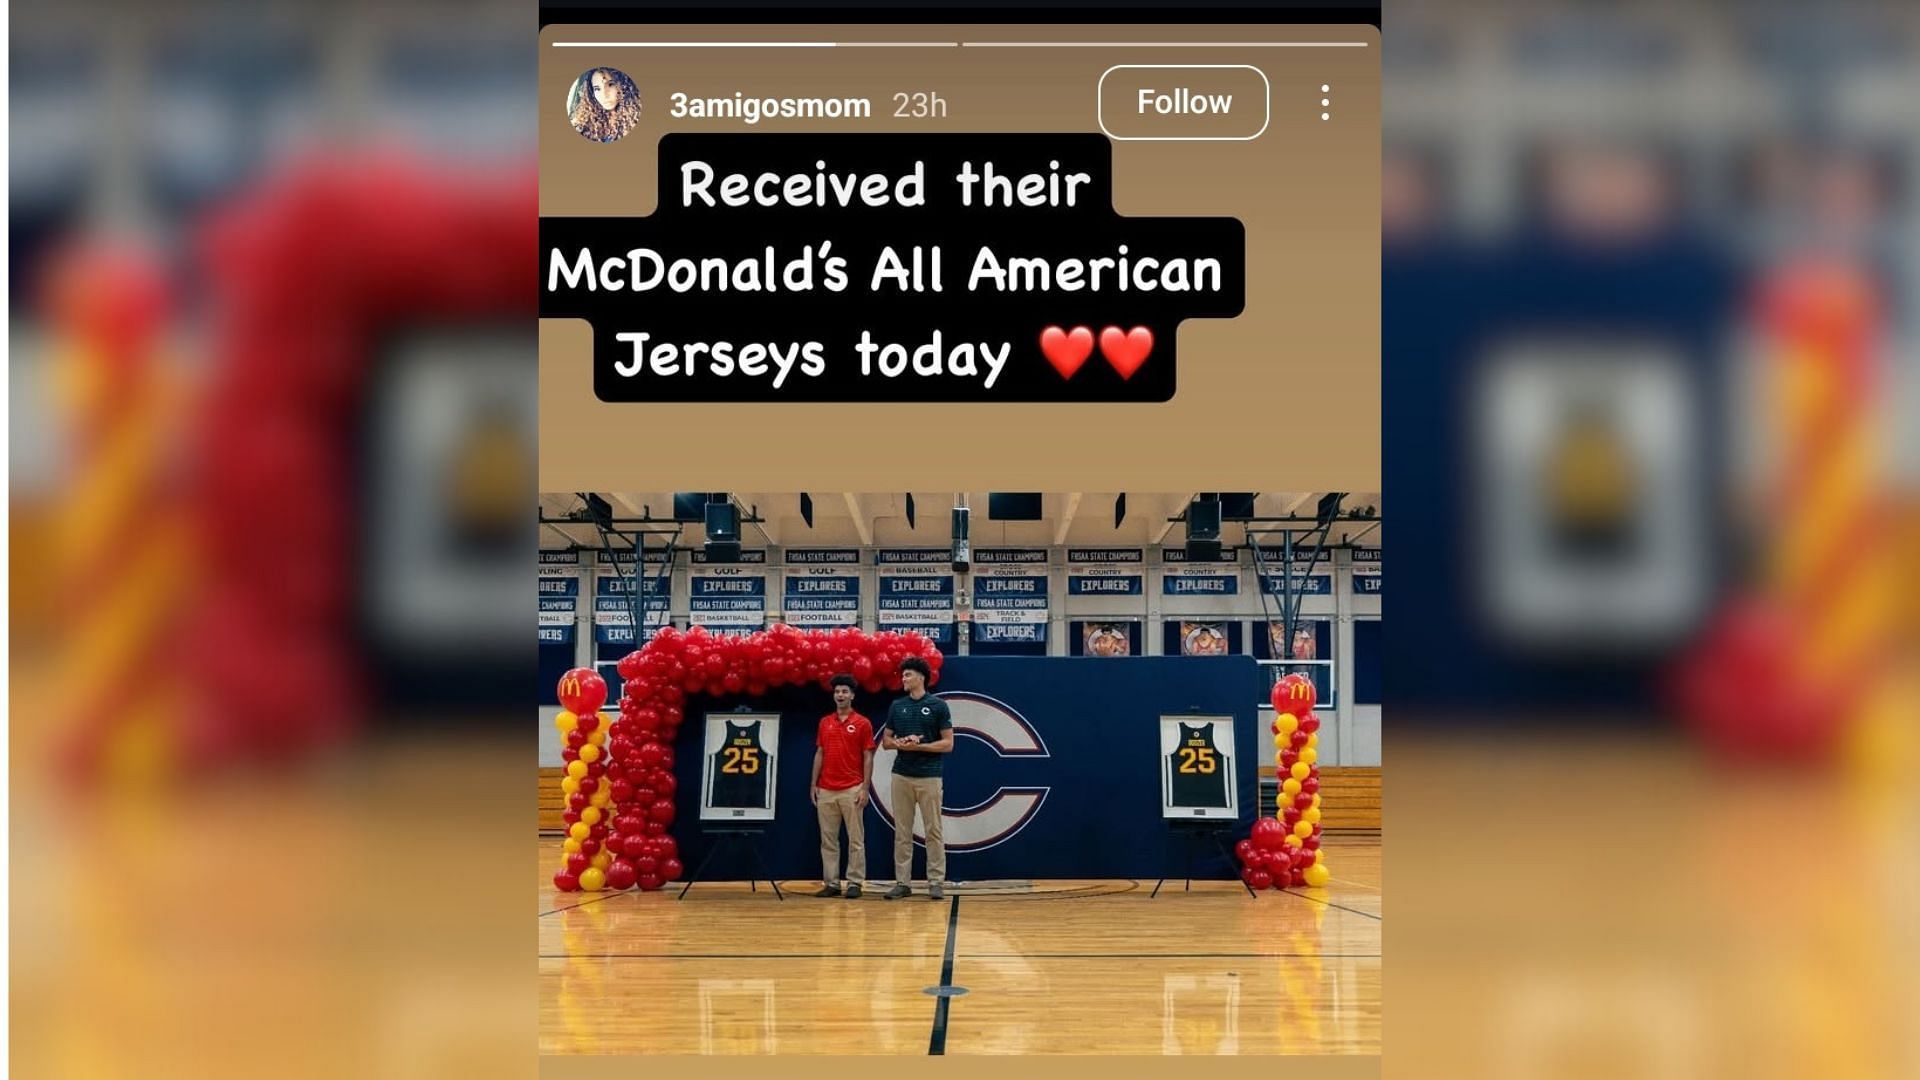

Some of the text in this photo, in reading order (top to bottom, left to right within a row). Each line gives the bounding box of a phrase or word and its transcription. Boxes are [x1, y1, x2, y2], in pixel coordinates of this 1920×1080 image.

[807, 553, 825, 561] STATE
[826, 553, 857, 561] CHAMPIONS
[901, 553, 919, 561] STATE
[920, 553, 951, 561] CHAMPIONS
[995, 553, 1013, 561] STATE
[1014, 553, 1045, 561] CHAMPIONS
[1070, 552, 1140, 561] FHSAA STATE CHAMPIONS
[704, 581, 753, 592] EXPLORERS
[797, 581, 847, 592] EXPLORERS
[892, 581, 941, 592] EXPLORERS
[986, 580, 1035, 592] EXPLORERS
[1081, 580, 1130, 591] EXPLORERS
[1176, 580, 1224, 591] EXPLORERS
[692, 601, 762, 610] FHSAA STATE CHAMPIONS
[787, 600, 857, 609] FHSAA STATE CHAMPIONS
[881, 600, 951, 608] FHSAA STATE CHAMPIONS
[976, 599, 1046, 608] FHSAA STATE CHAMPIONS
[986, 626, 1036, 639] EXPLORERS
[722, 747, 760, 774] 25
[1179, 747, 1217, 774] 25
